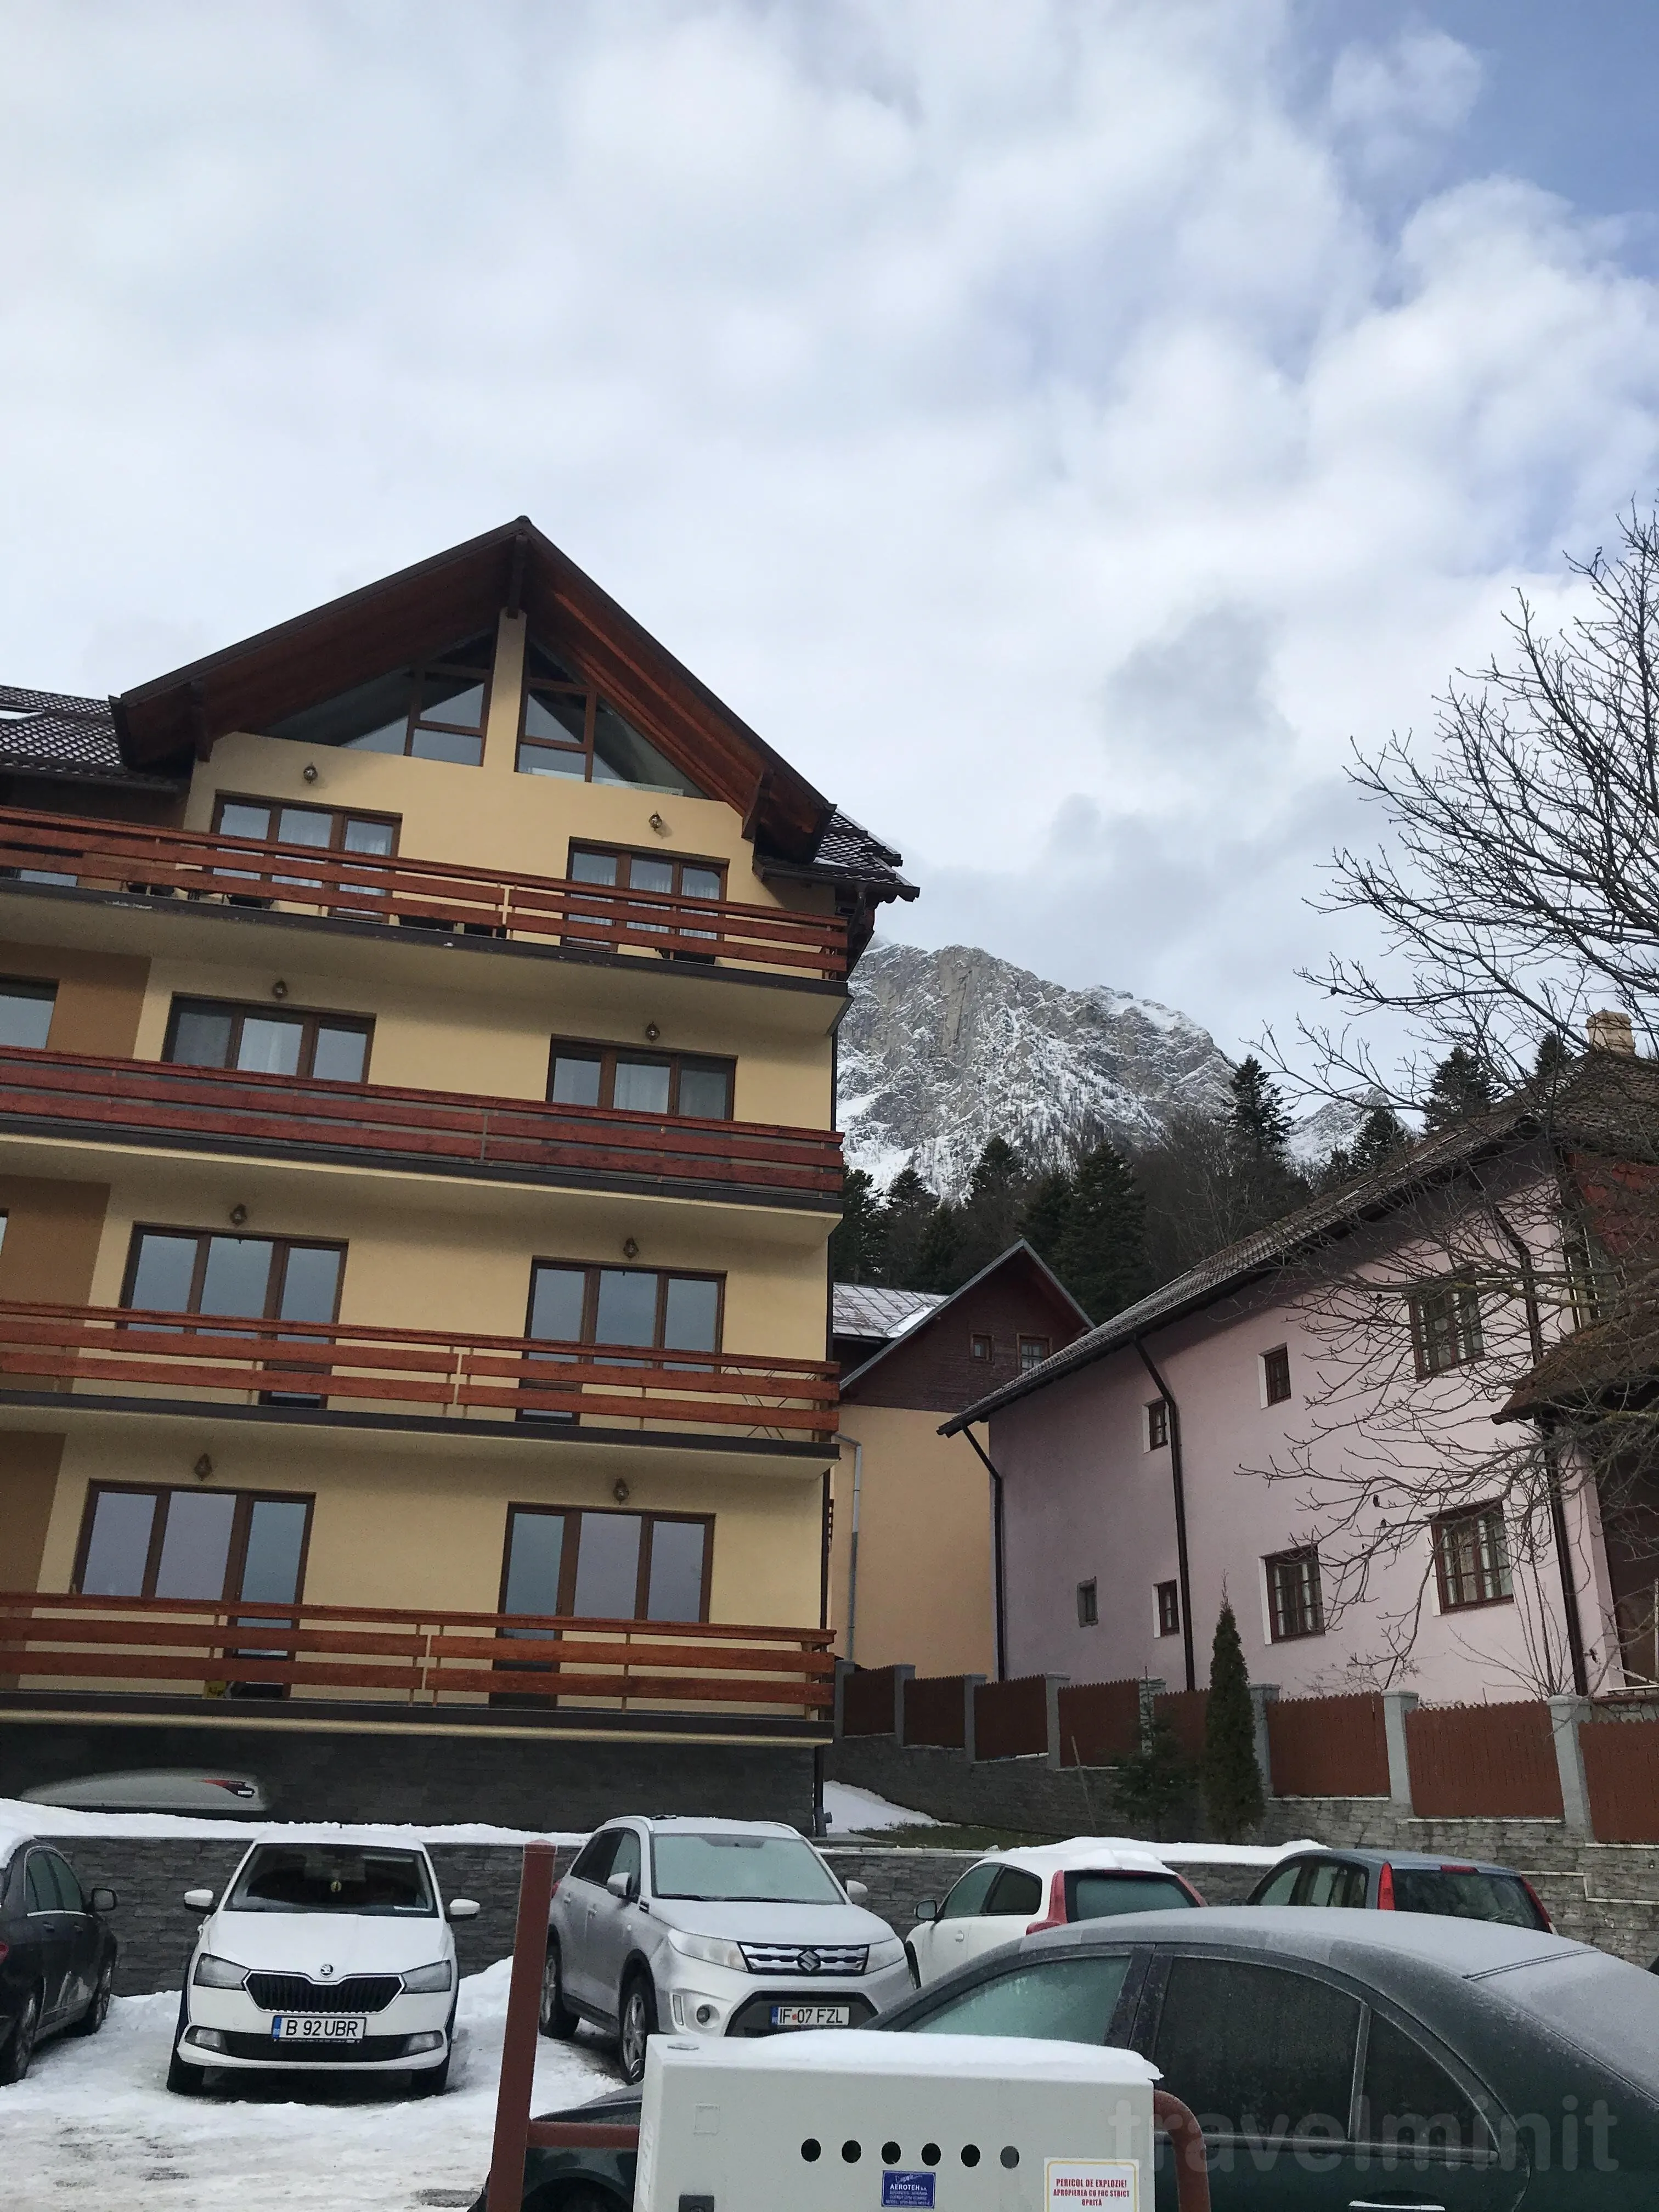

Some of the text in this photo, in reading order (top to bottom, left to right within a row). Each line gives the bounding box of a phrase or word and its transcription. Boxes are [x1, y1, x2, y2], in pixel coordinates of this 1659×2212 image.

[779, 2008, 793, 2023] IF
[797, 2008, 813, 2023] 07
[817, 2008, 843, 2023] FZL
[285, 2019, 298, 2036] B
[303, 2020, 322, 2036] 92
[324, 2021, 358, 2037] UBR
[1056, 2179, 1127, 2188] PERICOL DE EXPLOZIE!
